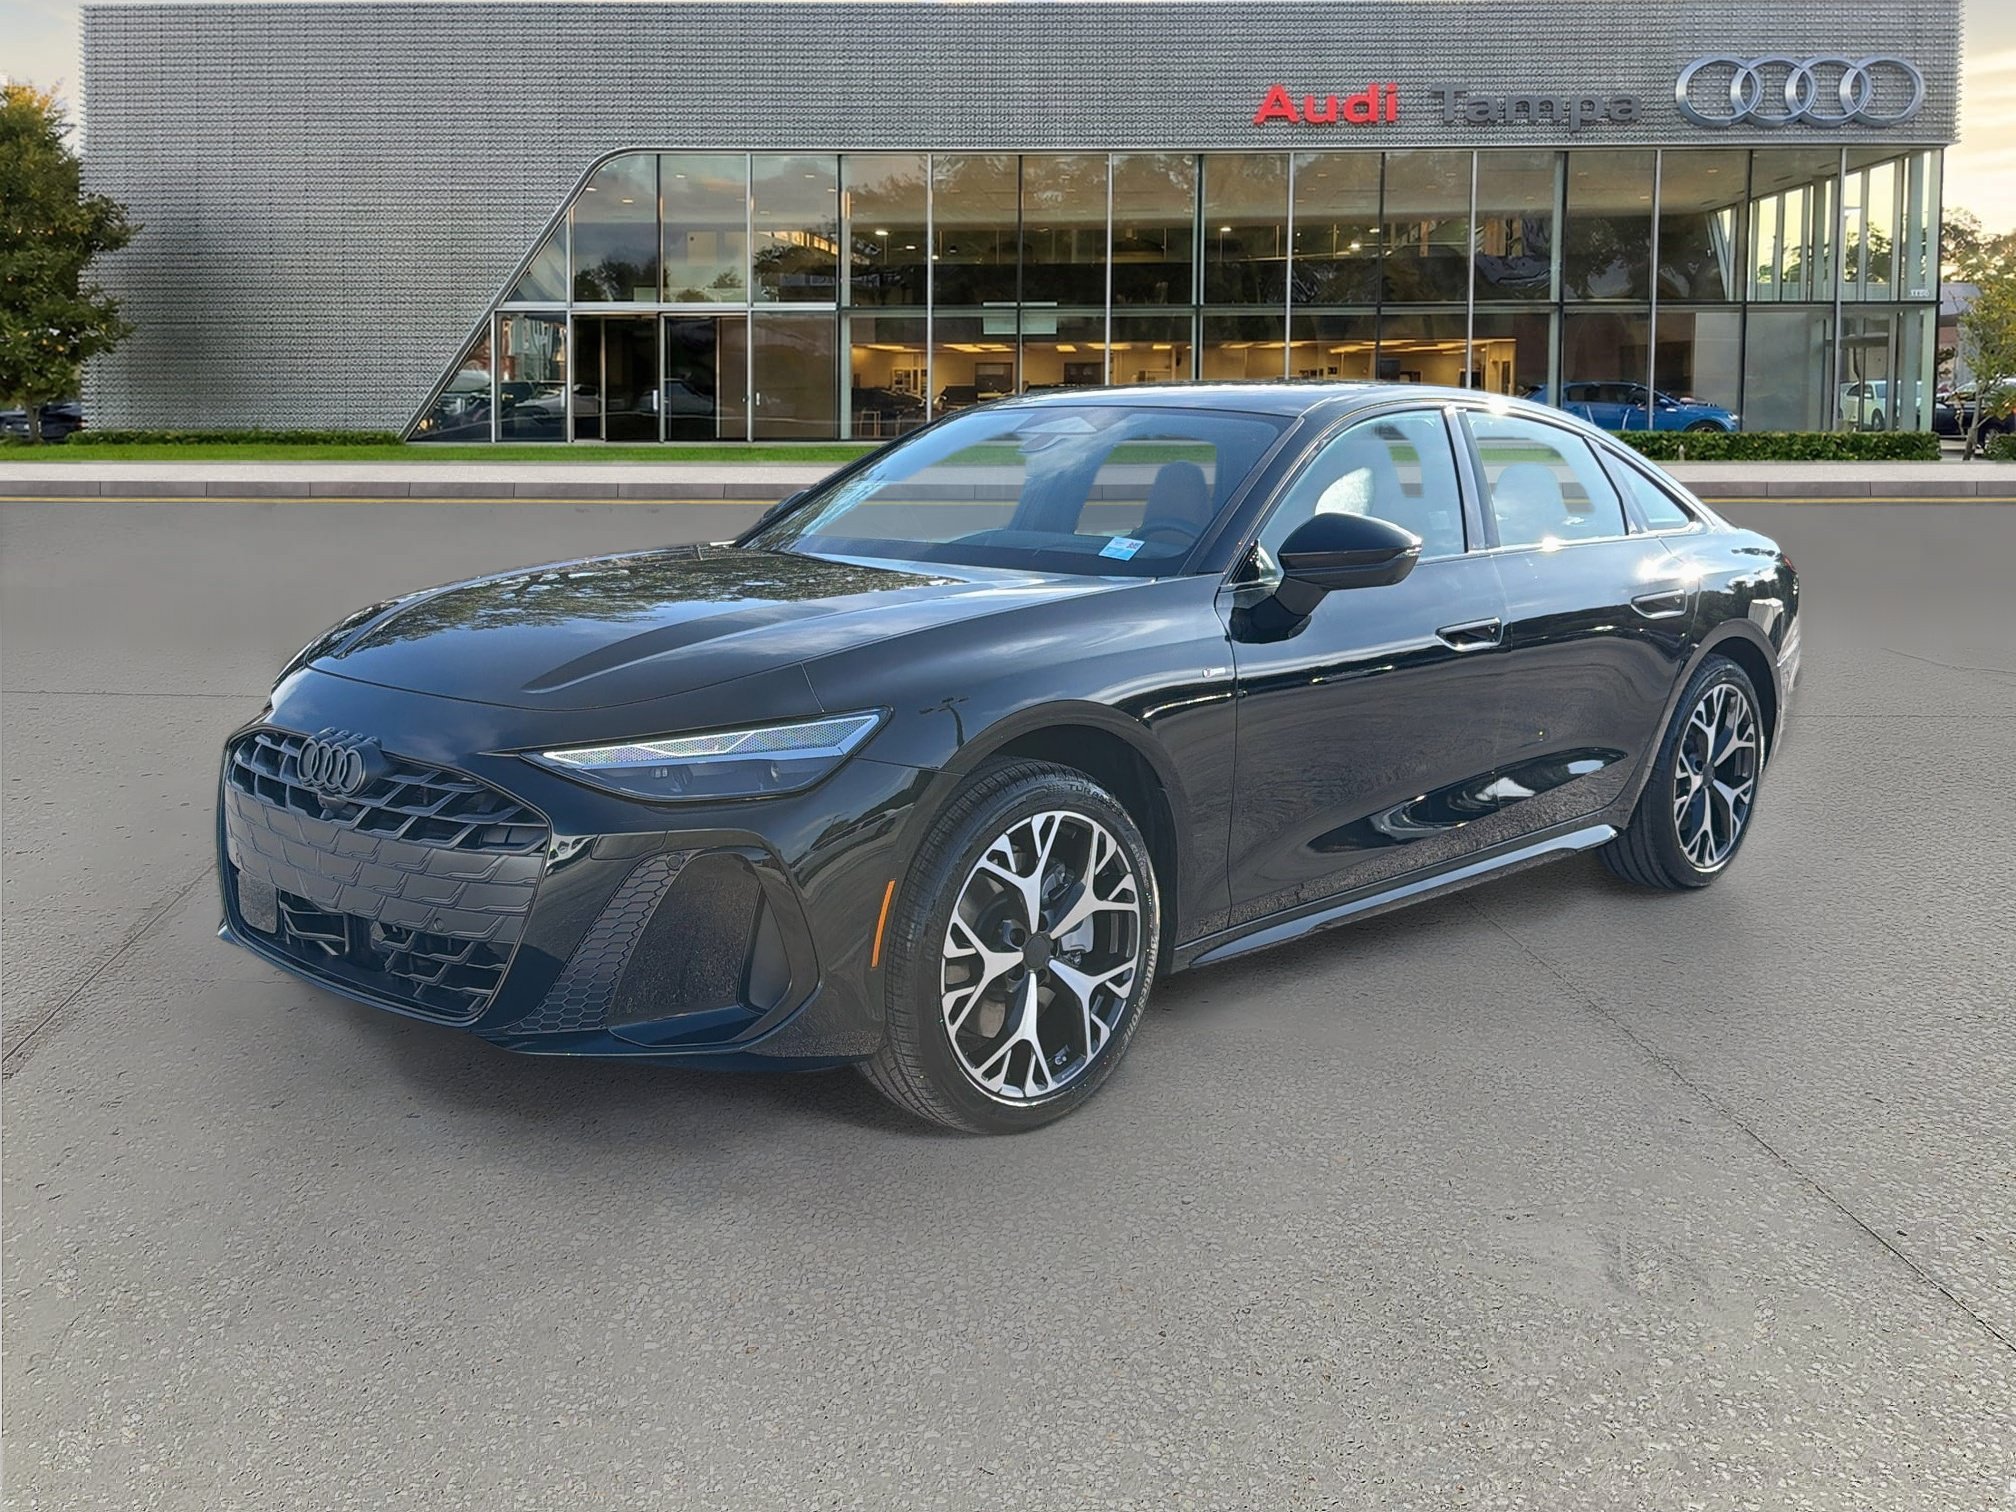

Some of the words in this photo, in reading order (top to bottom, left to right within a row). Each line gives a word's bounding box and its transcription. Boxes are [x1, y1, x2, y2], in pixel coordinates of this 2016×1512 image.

[1253, 83, 1398, 125] Audi
[1430, 83, 1641, 132] Tampa
[1122, 936, 1158, 1047] BRIDGESTONE
